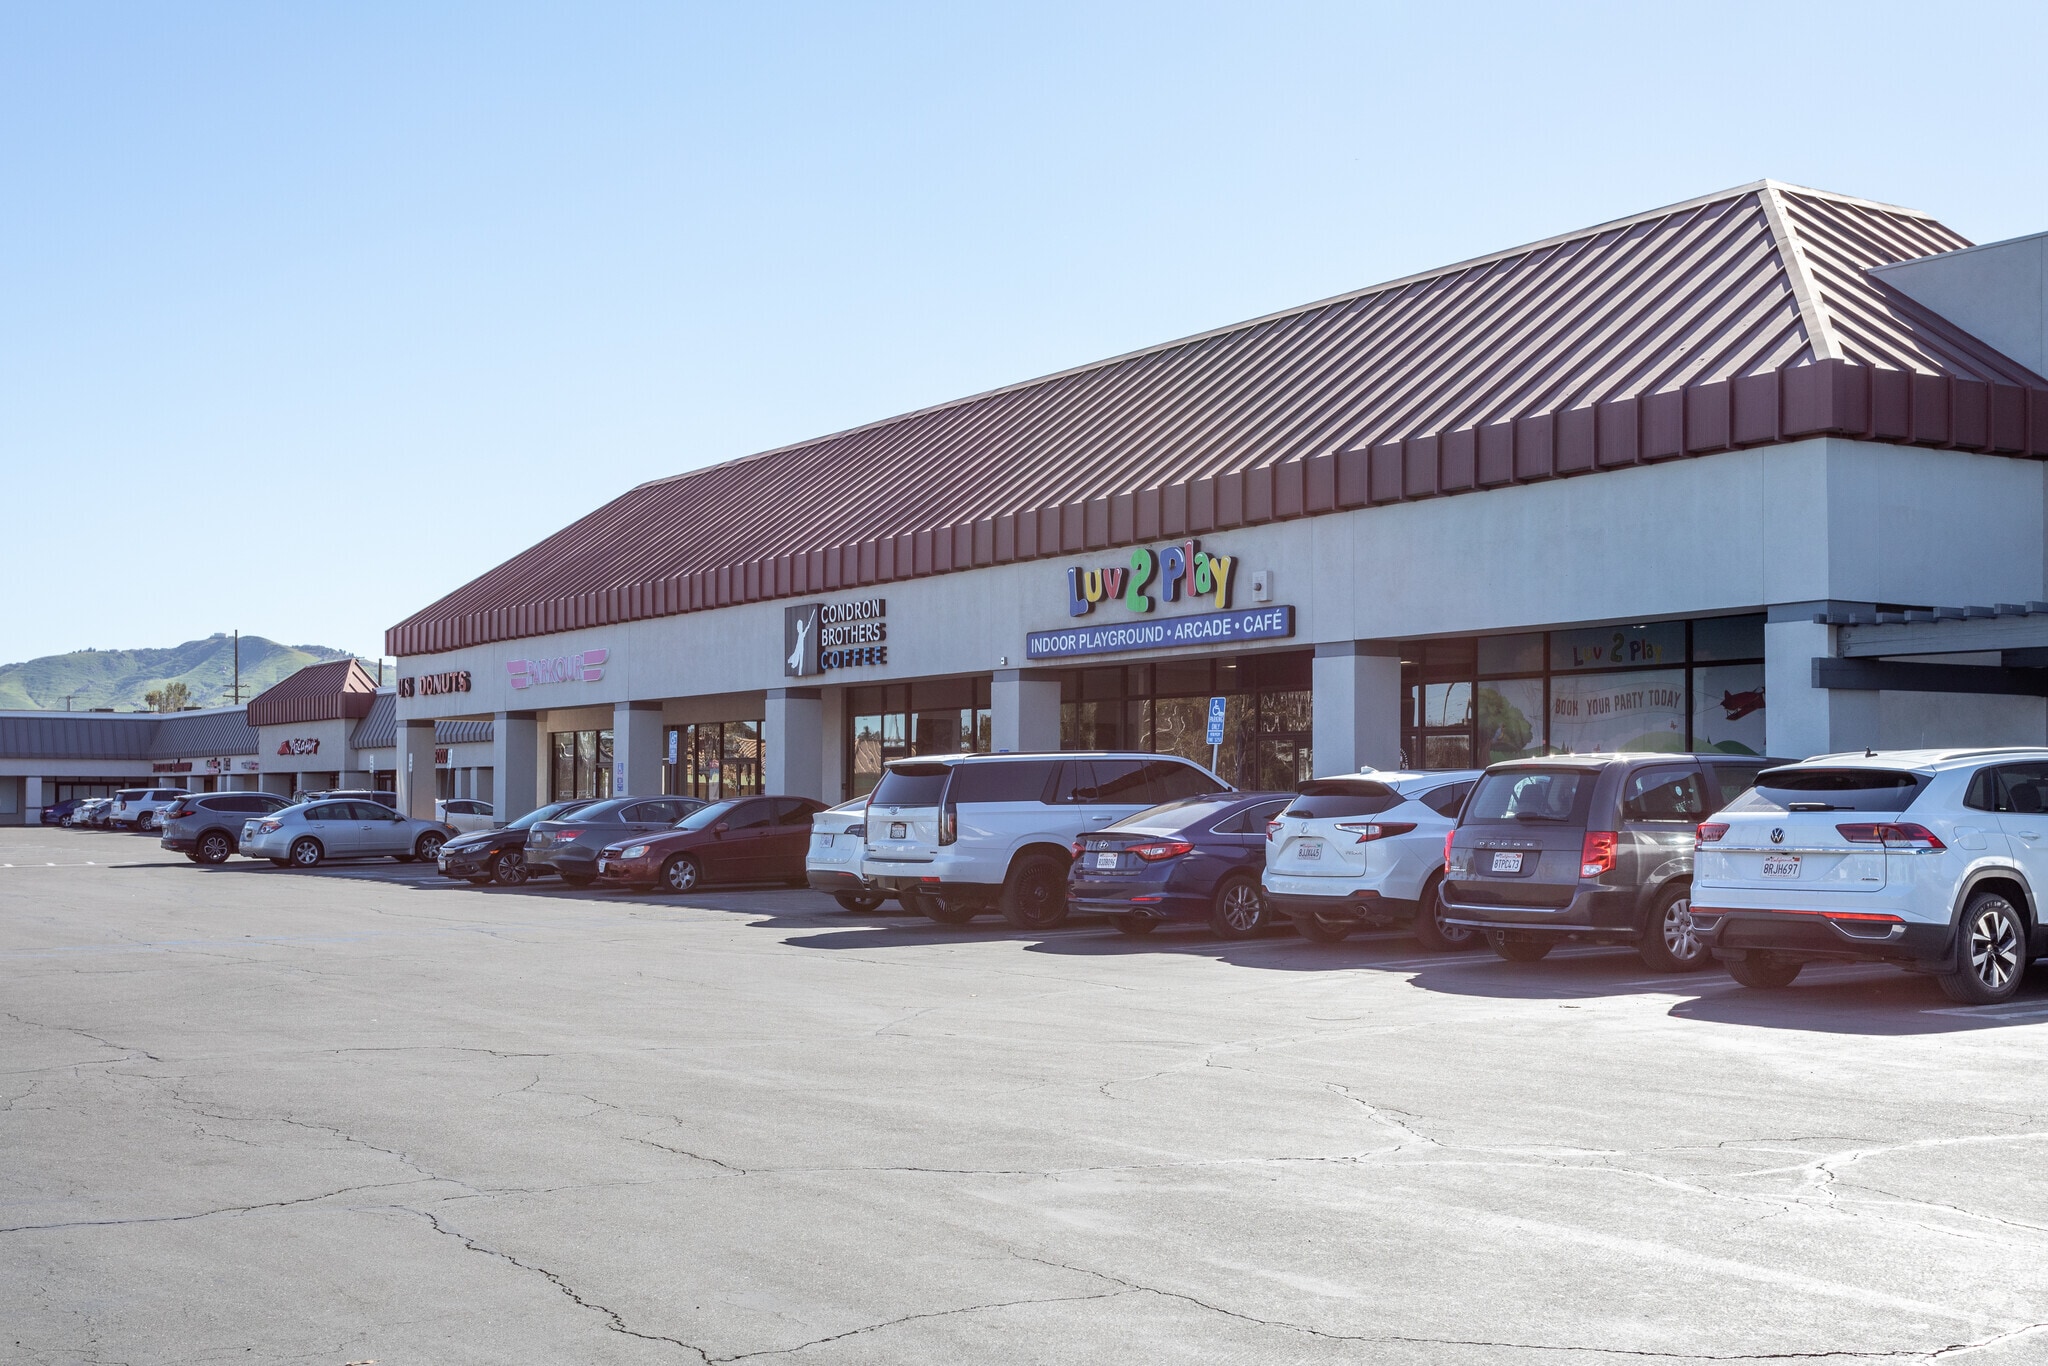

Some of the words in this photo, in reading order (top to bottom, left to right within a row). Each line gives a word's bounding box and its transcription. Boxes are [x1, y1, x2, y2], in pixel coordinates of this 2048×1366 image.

[1067, 567, 1128, 617] Luv
[1126, 548, 1158, 613] 2
[1159, 539, 1238, 609] Play
[821, 598, 886, 624] CONDRON
[821, 623, 886, 647] BROTHERS
[1031, 636, 1076, 653] INDOOR
[1079, 626, 1164, 648] PLAYGROUND
[1174, 618, 1232, 640] ARCADE
[1243, 609, 1282, 633] CAFÉ
[821, 646, 887, 670] COFFEE
[1572, 646, 1603, 667] Luv
[1609, 632, 1625, 663] 2
[1629, 639, 1663, 664] Play
[419, 671, 471, 695] DONUTS
[527, 654, 584, 687] PARKOUR
[1555, 698, 1579, 717] BOOK
[1587, 696, 1611, 715] YOUR
[1614, 691, 1643, 711] PARTY
[1648, 689, 1681, 709] TODAY
[1763, 863, 1798, 874] 8RJH697
